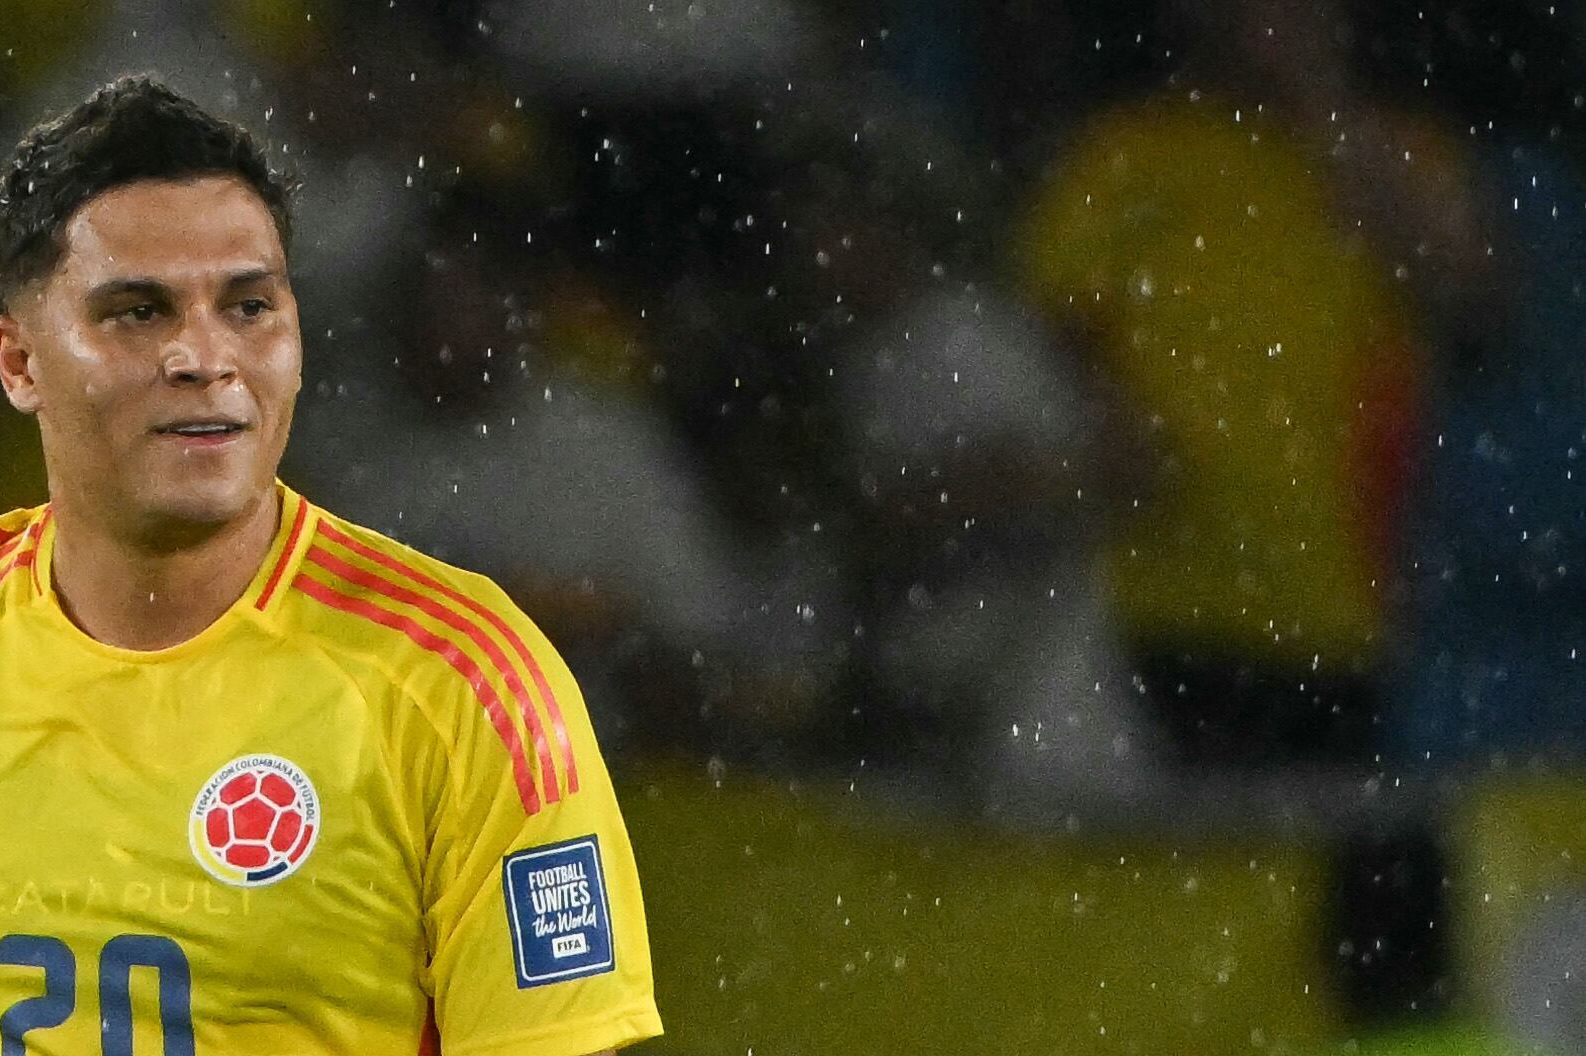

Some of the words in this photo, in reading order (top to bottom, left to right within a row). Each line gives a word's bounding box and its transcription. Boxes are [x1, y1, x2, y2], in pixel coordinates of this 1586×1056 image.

[235, 757, 293, 777] COLOMBIANA
[528, 861, 588, 890] FOOTBALL
[531, 880, 591, 914] UNITES
[531, 912, 556, 937] the
[557, 904, 597, 933] World
[557, 940, 582, 953] FIFA
